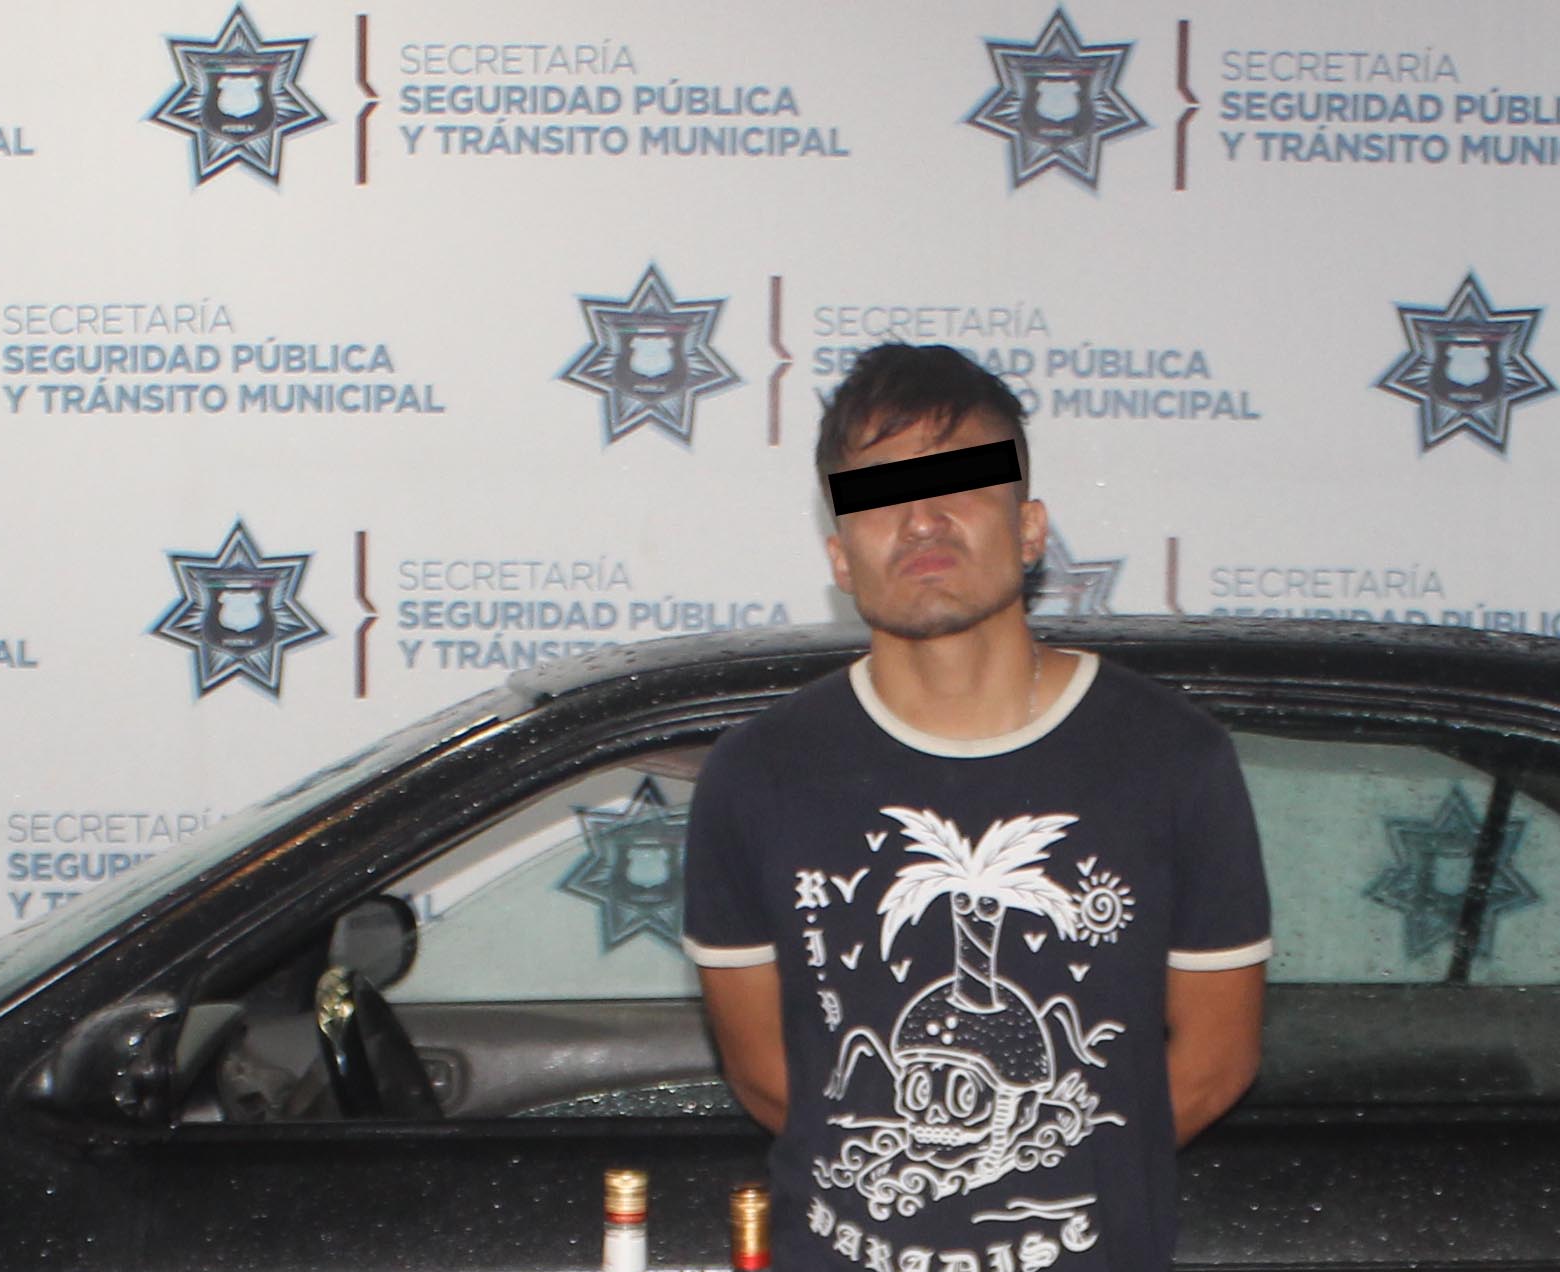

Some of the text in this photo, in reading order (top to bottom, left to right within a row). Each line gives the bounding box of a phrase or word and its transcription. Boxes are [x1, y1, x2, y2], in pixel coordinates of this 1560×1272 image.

[400, 38, 638, 75] SECRETARÍA
[1221, 46, 1461, 83] SECRETARÍA
[399, 77, 799, 116] SEGURIDAD PÚBLICA
[1220, 90, 1445, 123] SEGURIDAD
[399, 117, 850, 156] Y TRÁNSITO MUNICIPAL
[1219, 131, 1246, 160] Y
[1254, 125, 1450, 163] TRÁNSITO
[2, 297, 235, 335] SECRETARÍA
[814, 302, 1050, 338] SECRETARÍA
[2, 336, 395, 374] SEGURIDAD PÚBLICA
[1047, 342, 1213, 380] PÚBLICA
[2, 376, 446, 413] Y TRÁNSITO MUNICIPAL
[1053, 389, 1263, 421] MUNICIPAL
[398, 555, 632, 591] SECRETARÍA
[1210, 564, 1445, 599] SECRETARÍA
[398, 595, 789, 631] SEGURIDAD PÚBLICA
[398, 640, 423, 669] Y
[8, 892, 30, 919] Y
